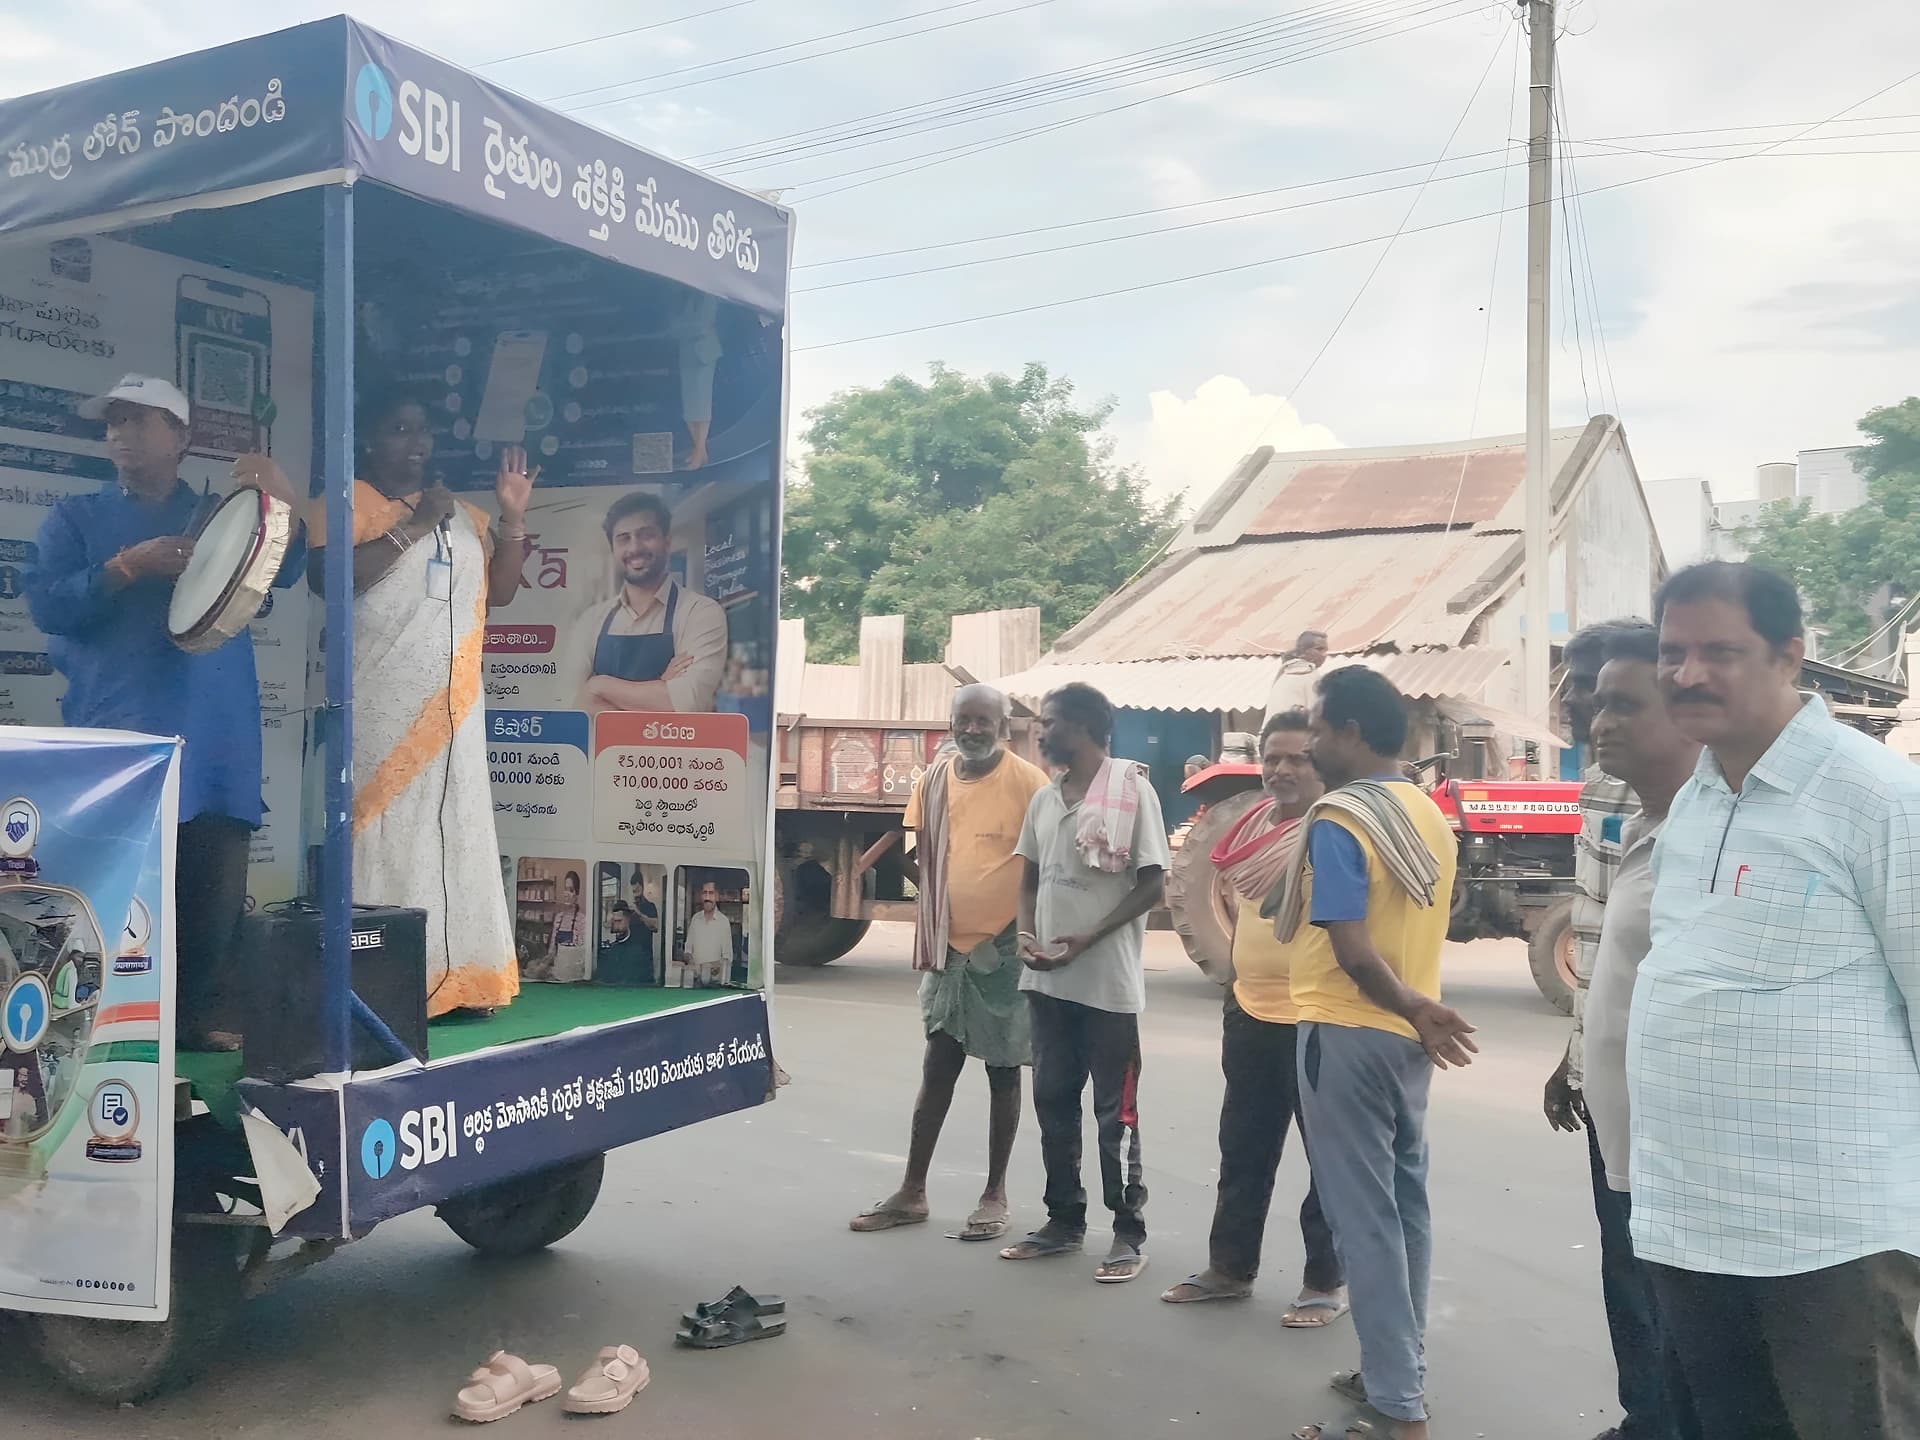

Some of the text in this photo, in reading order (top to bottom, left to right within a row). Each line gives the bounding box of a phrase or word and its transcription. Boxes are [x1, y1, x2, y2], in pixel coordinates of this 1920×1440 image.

[7, 78, 286, 180] ముద్ర లోన్ పొందండి
[399, 80, 461, 172] SBI
[483, 116, 760, 273] రైతుల శక్తికి మేము తోడు
[494, 716, 544, 737] కిషోర్
[487, 751, 560, 767] 0,001 నుండి
[688, 757, 725, 772] నుండి
[613, 775, 728, 792] ₹10,00,000 వరకు
[1523, 803, 1579, 813] FERGUSO
[497, 1087, 549, 1129] మోసానికి
[551, 1076, 584, 1121] గురైతే
[627, 1064, 659, 1095] 1930
[705, 1042, 725, 1072] కాల్
[399, 1101, 458, 1170] SBI
